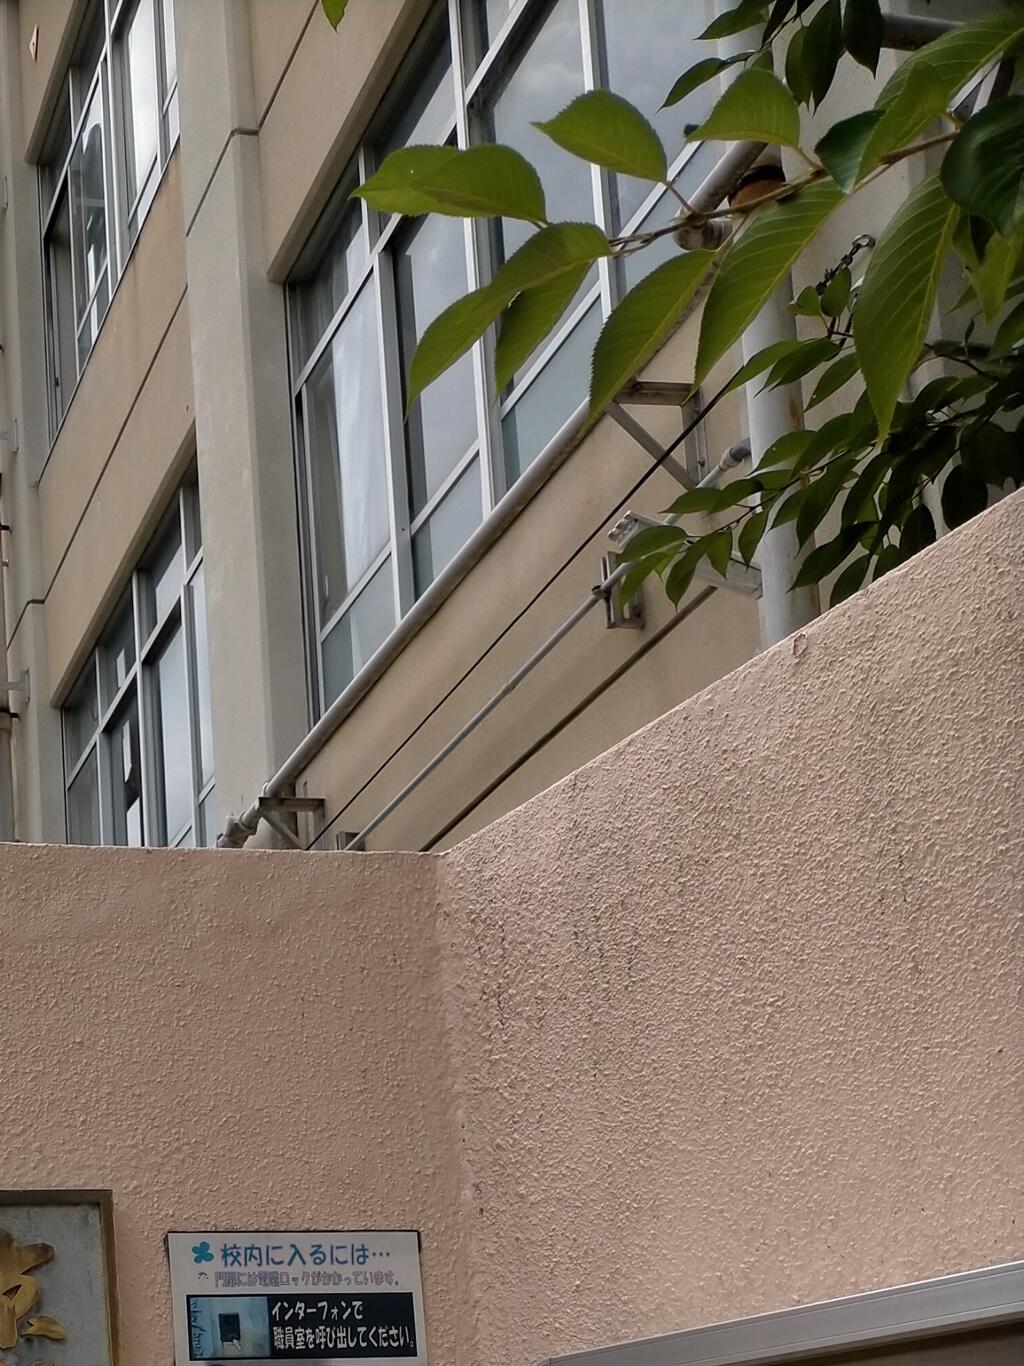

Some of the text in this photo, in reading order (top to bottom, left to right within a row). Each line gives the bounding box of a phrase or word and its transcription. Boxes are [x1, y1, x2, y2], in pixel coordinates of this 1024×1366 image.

[220, 1243, 391, 1267] 校内に入るには…
[272, 1300, 364, 1321] インターフォンで
[272, 1325, 414, 1350] 職員室を呼び出してください。
